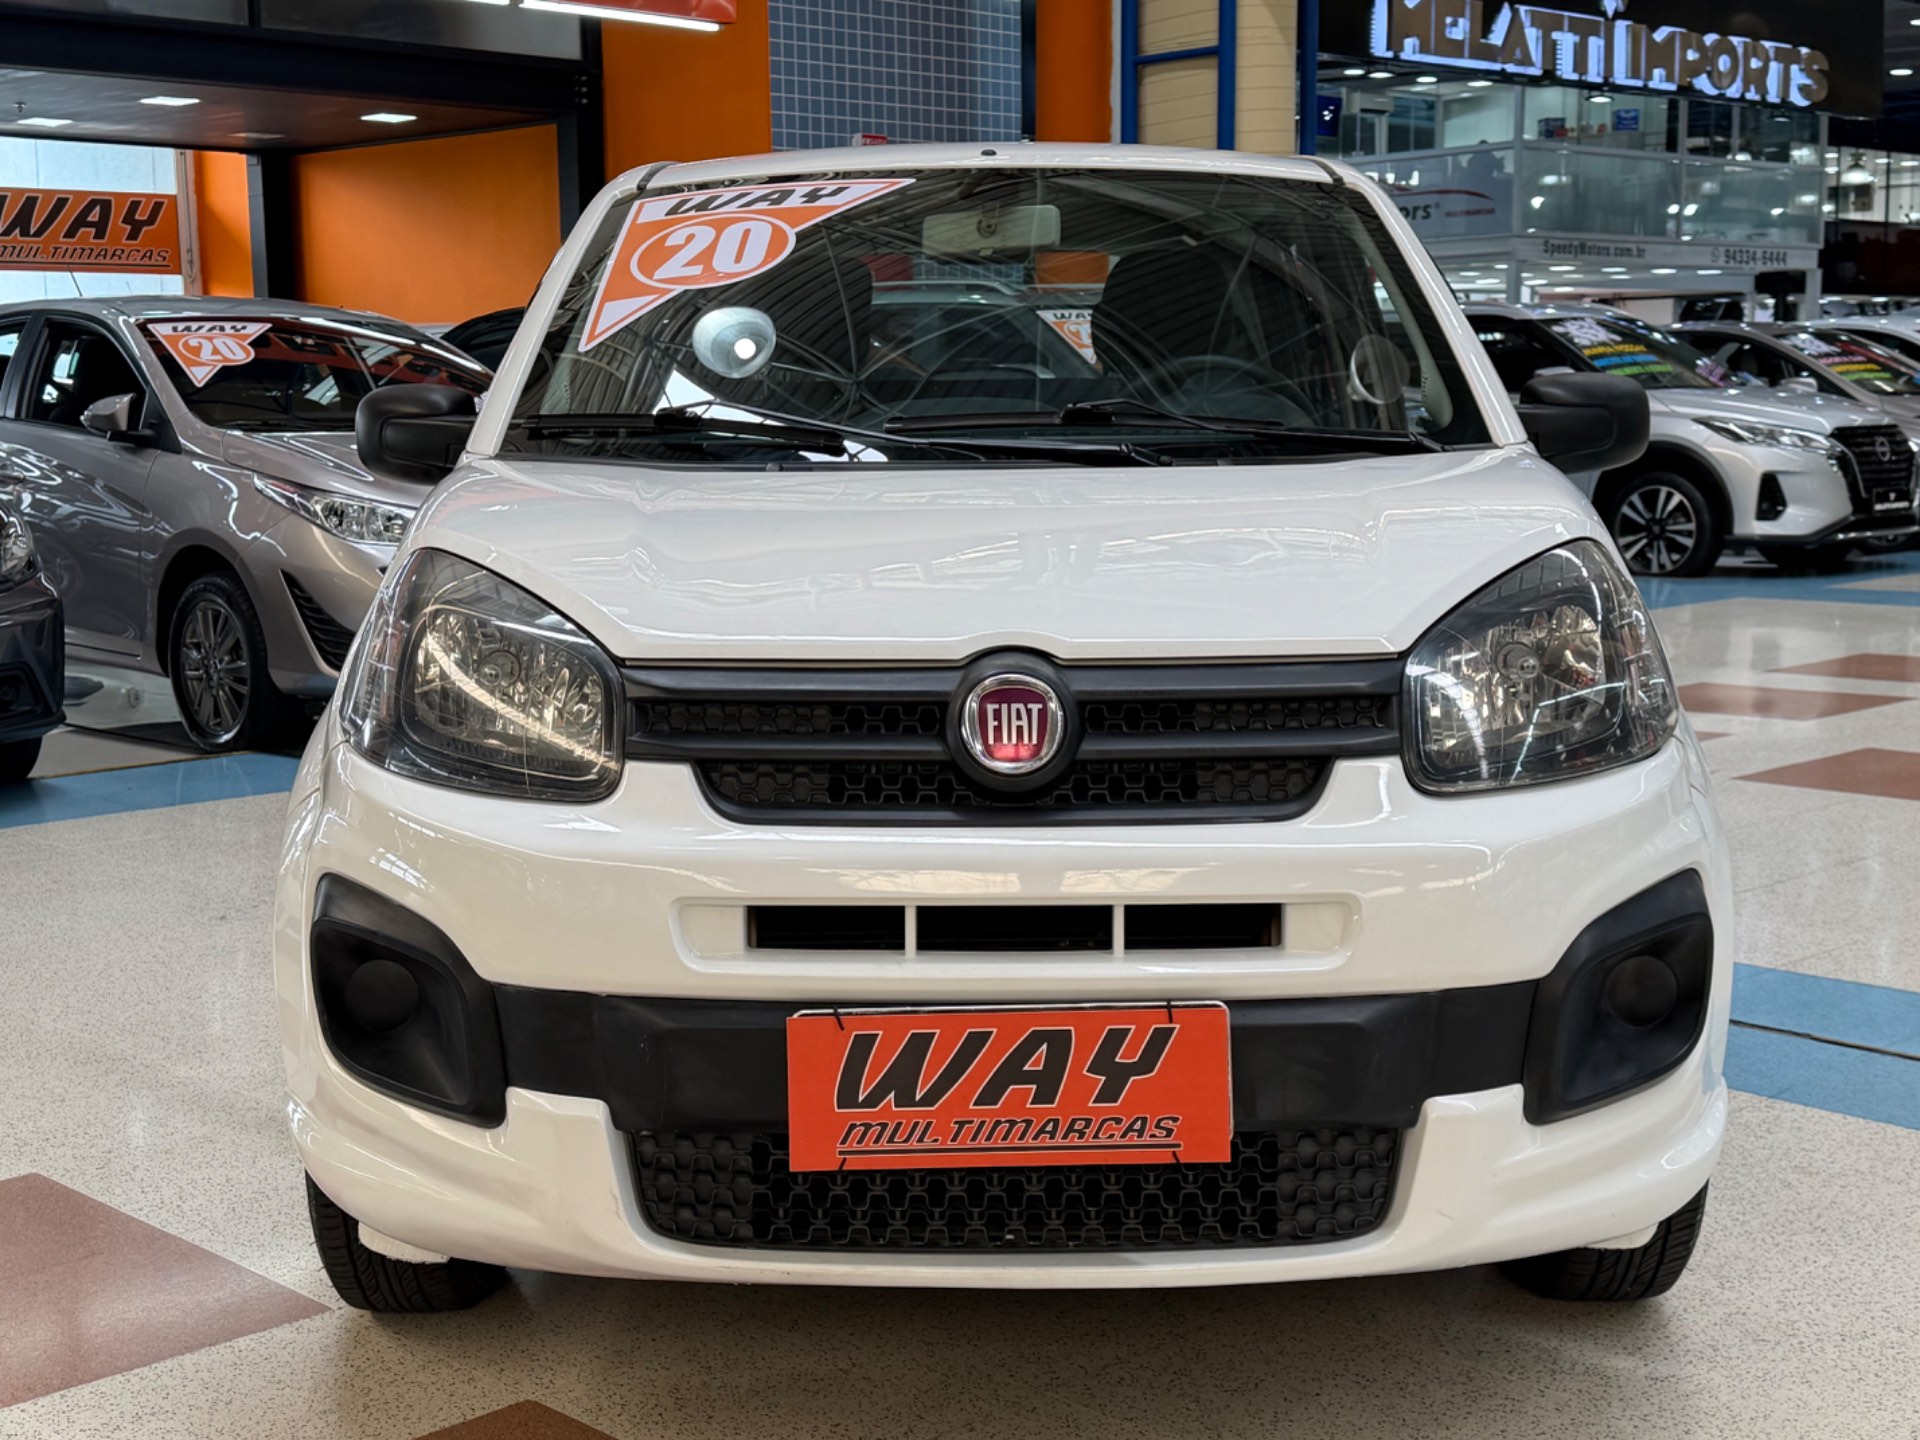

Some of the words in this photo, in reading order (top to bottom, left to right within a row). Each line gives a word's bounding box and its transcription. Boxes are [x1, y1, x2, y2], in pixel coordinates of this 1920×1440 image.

[0, 193, 168, 244] WAY
[664, 185, 851, 217] WAY
[652, 220, 773, 281] 20
[171, 324, 248, 333] WAY
[187, 337, 248, 361] 20
[986, 702, 1043, 746] FIAT
[834, 1023, 1181, 1113] WAY
[838, 1114, 1184, 1147] MULTIMARCAS
